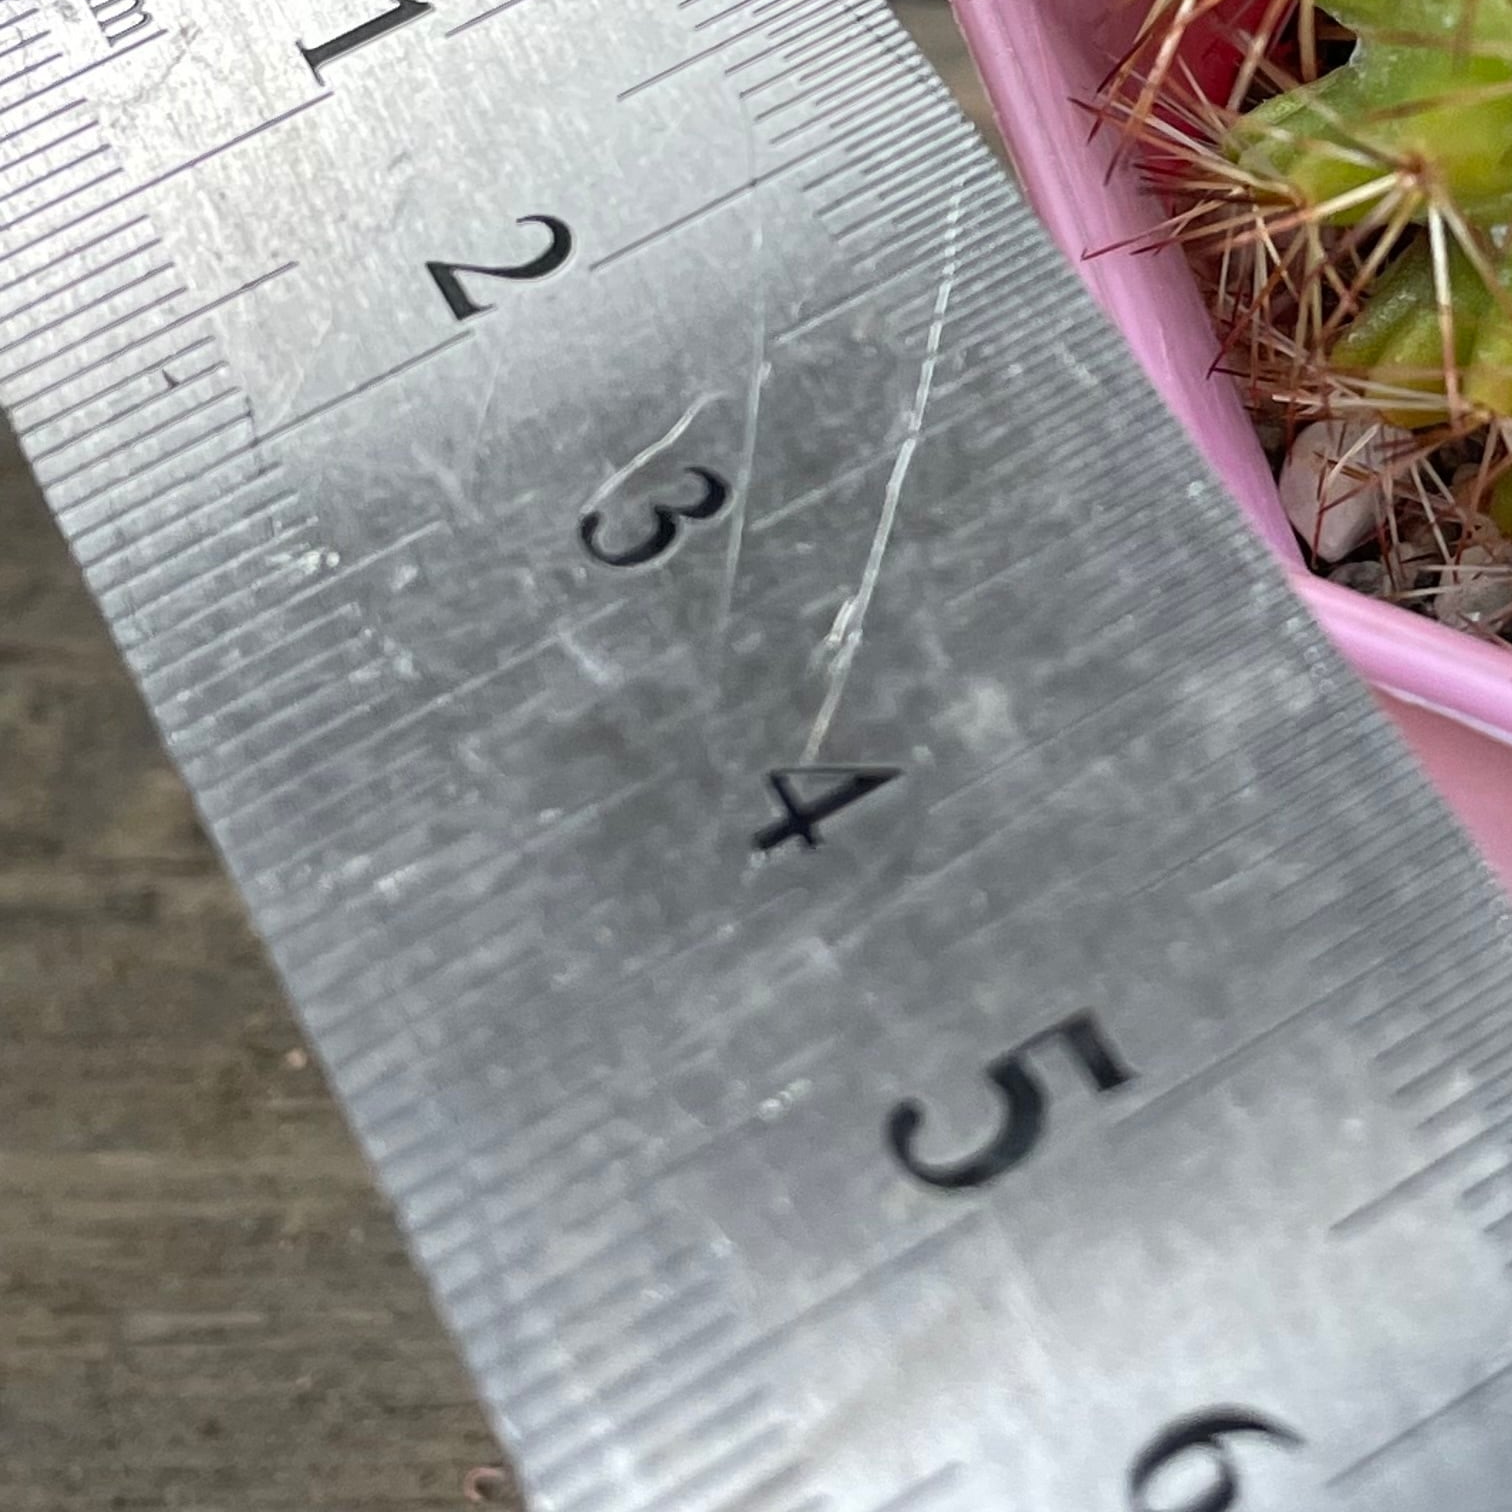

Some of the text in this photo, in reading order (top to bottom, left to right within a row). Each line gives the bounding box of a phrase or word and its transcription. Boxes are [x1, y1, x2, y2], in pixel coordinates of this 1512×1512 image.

[426, 215, 573, 320] 2
[580, 465, 734, 568] 3
[752, 765, 905, 850] 4
[885, 1005, 1140, 1190] 5
